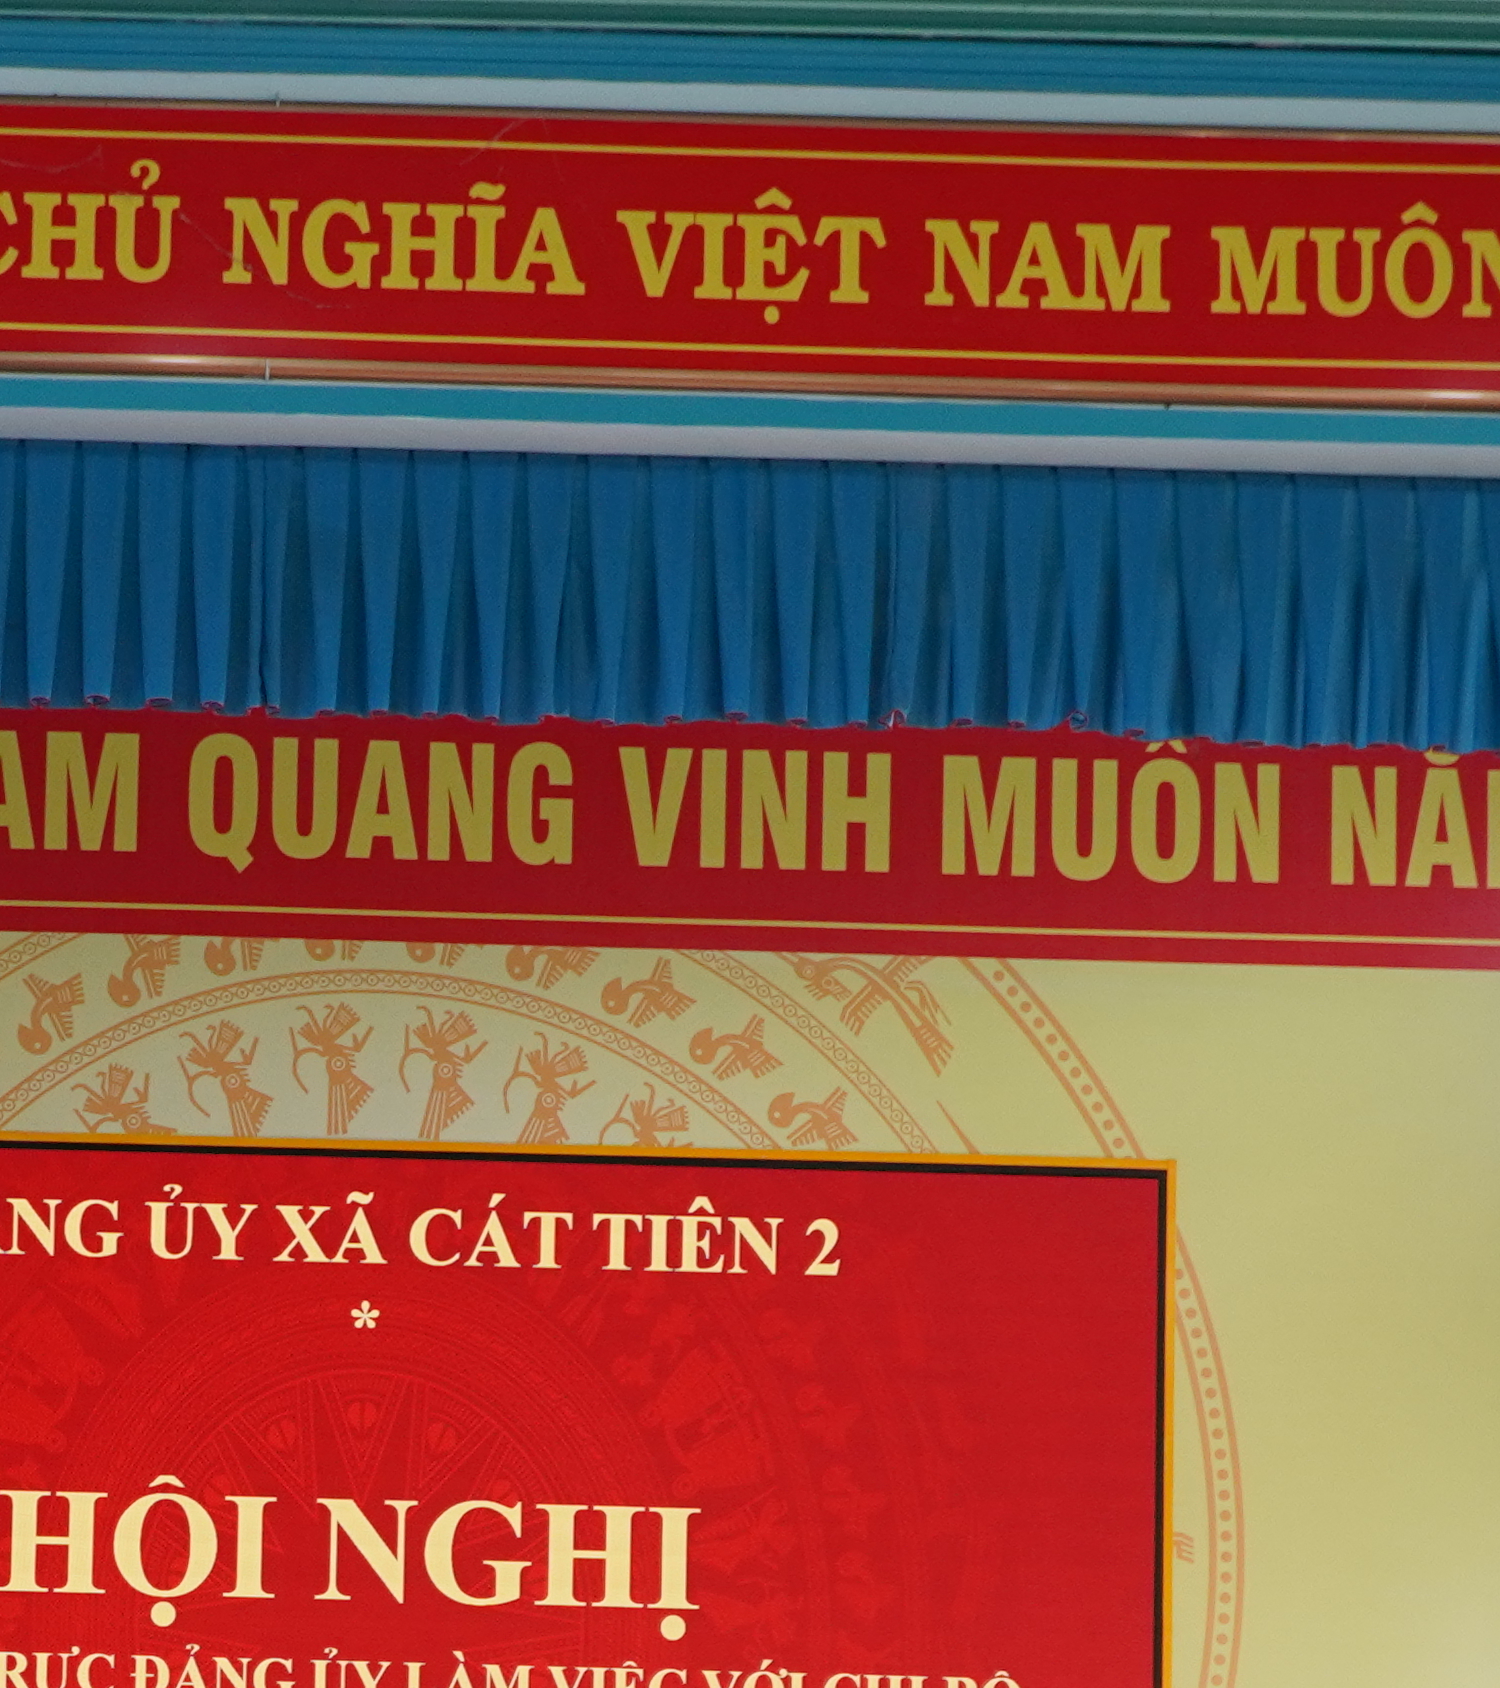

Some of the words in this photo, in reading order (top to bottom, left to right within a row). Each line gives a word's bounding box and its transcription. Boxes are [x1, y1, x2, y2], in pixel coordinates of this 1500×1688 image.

[223, 182, 585, 295] NGHĨA
[616, 187, 886, 324] VIỆT
[925, 219, 1170, 312] NAM
[188, 733, 573, 873] QUANG
[619, 747, 891, 872] VINH
[942, 735, 1280, 883] MUÔN
[145, 1184, 258, 1260] ỦY
[273, 1191, 387, 1264] XÃ
[409, 1193, 573, 1268] CÁT
[593, 1196, 783, 1274] TIÊN
[805, 1219, 840, 1276] 2
[314, 1498, 701, 1641] NGHỊ
